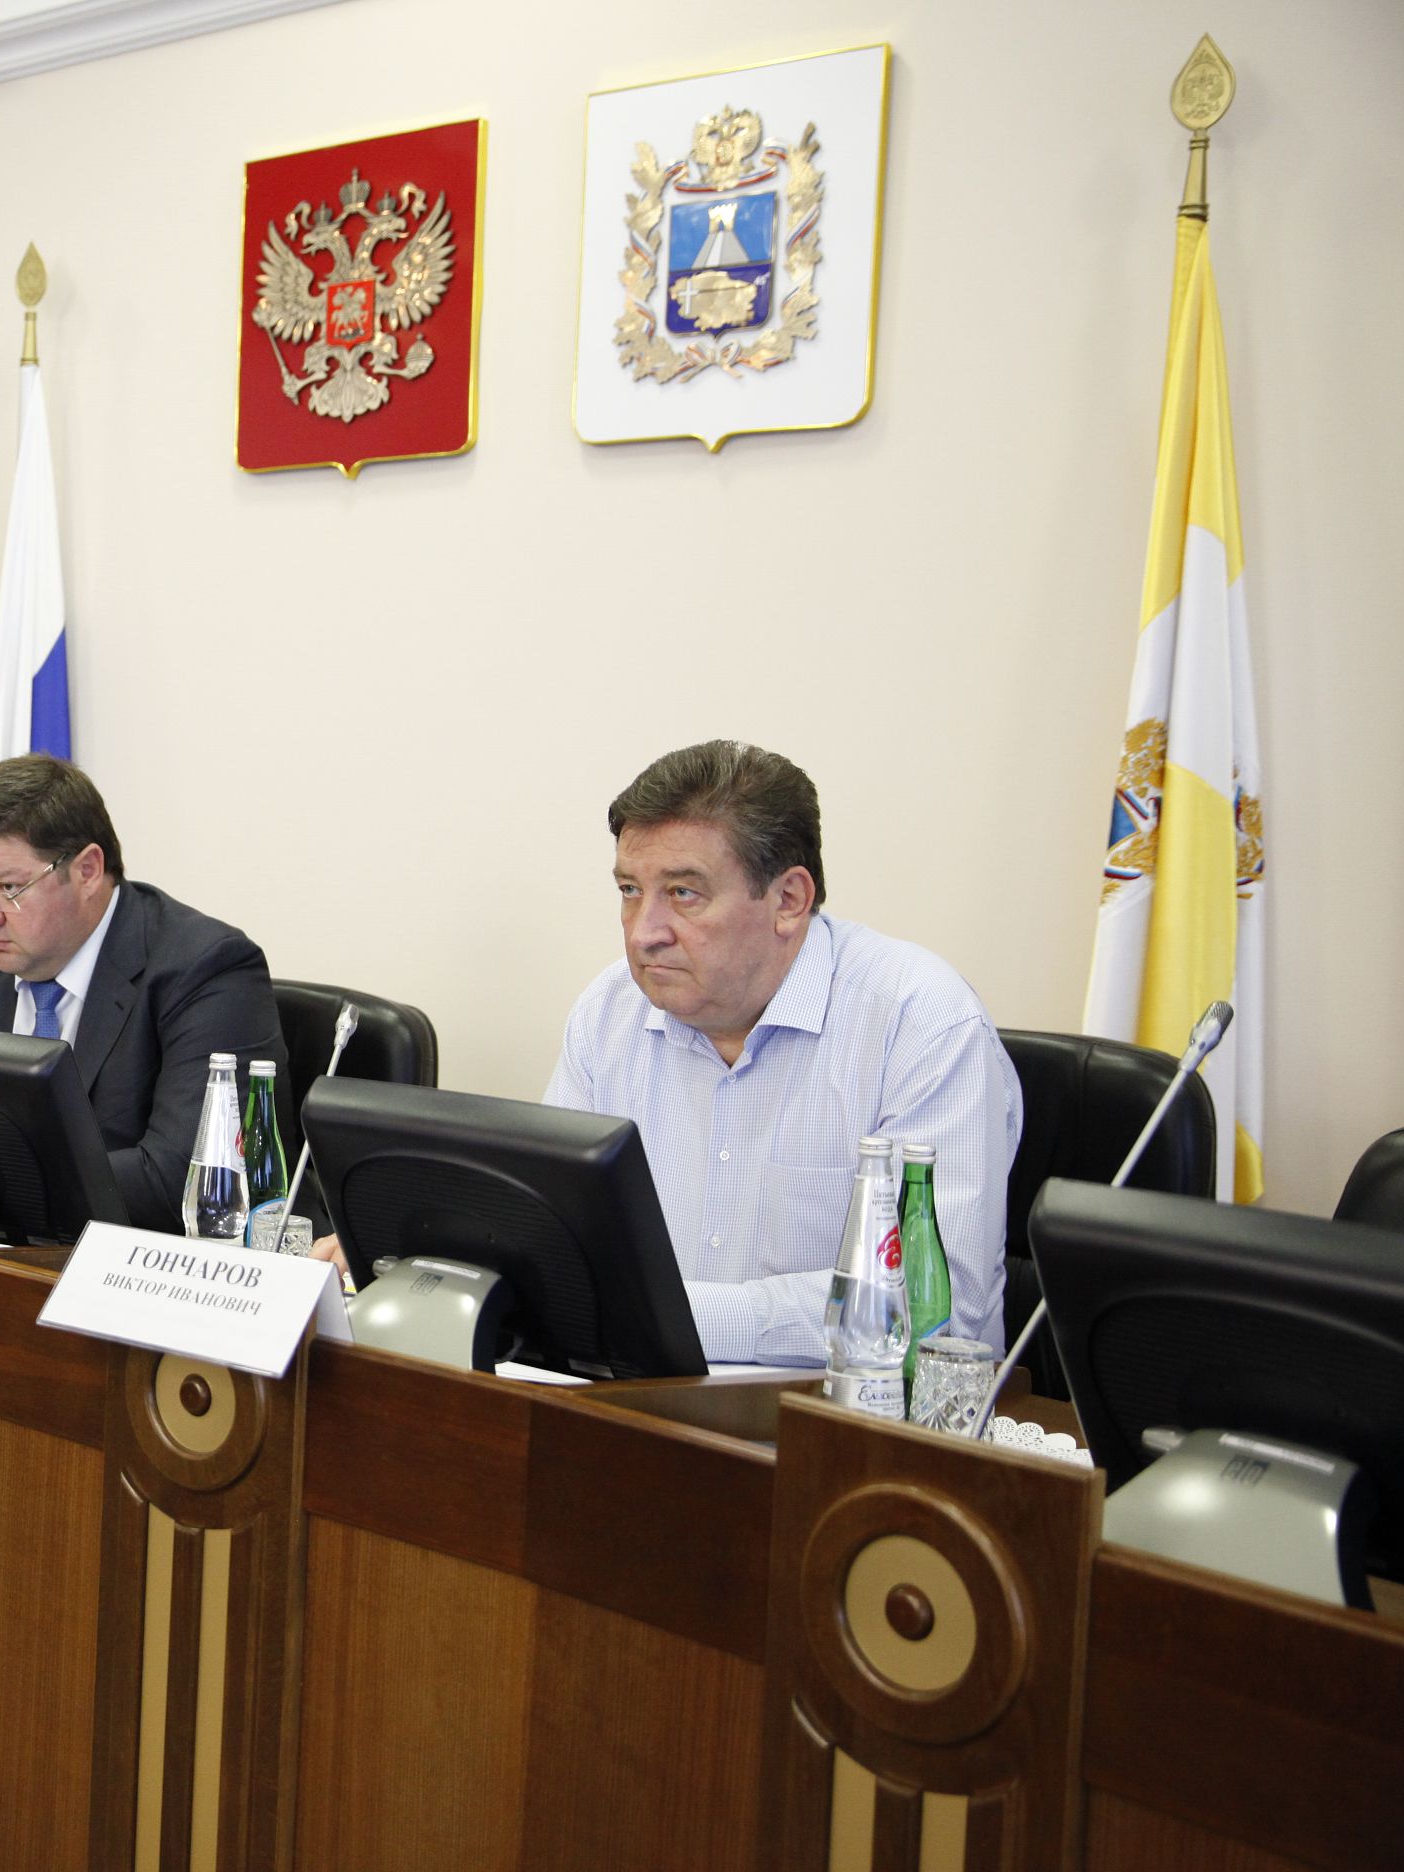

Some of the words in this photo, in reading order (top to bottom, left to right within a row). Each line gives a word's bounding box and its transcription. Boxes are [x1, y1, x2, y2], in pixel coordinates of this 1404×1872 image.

[127, 1246, 262, 1287] ГОНЧАРОВ
[102, 1272, 168, 1296] ВИКТОР
[169, 1286, 262, 1315] ИВАНОВИЧ
